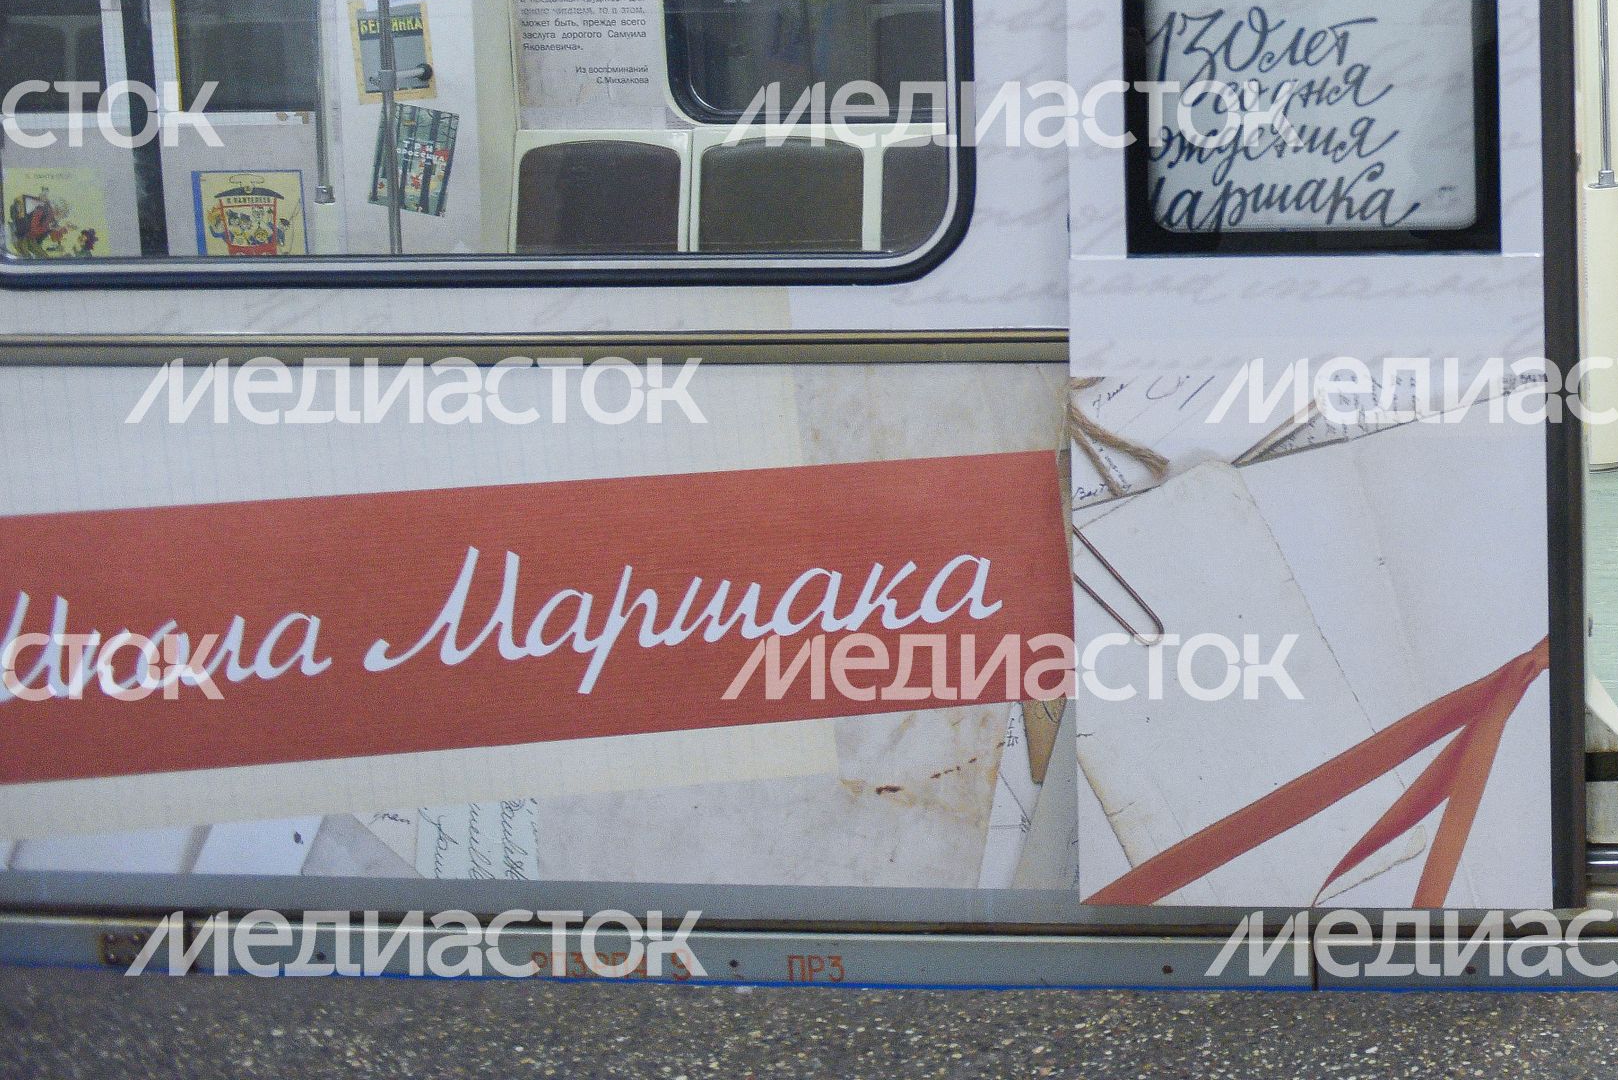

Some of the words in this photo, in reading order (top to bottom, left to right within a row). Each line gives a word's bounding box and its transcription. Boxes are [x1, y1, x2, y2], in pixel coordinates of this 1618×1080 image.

[520, 19, 551, 27] может
[582, 18, 617, 28] прежде
[620, 18, 646, 27] всего
[522, 31, 556, 40] заслуга
[561, 31, 602, 41] дорогого
[607, 29, 647, 39] Самуила
[1257, 17, 1379, 74] лет
[575, 65, 587, 74] Из
[588, 64, 649, 74] воспоминаний
[596, 76, 650, 85] С.Михалкова
[364, 544, 1005, 697] Маршака
